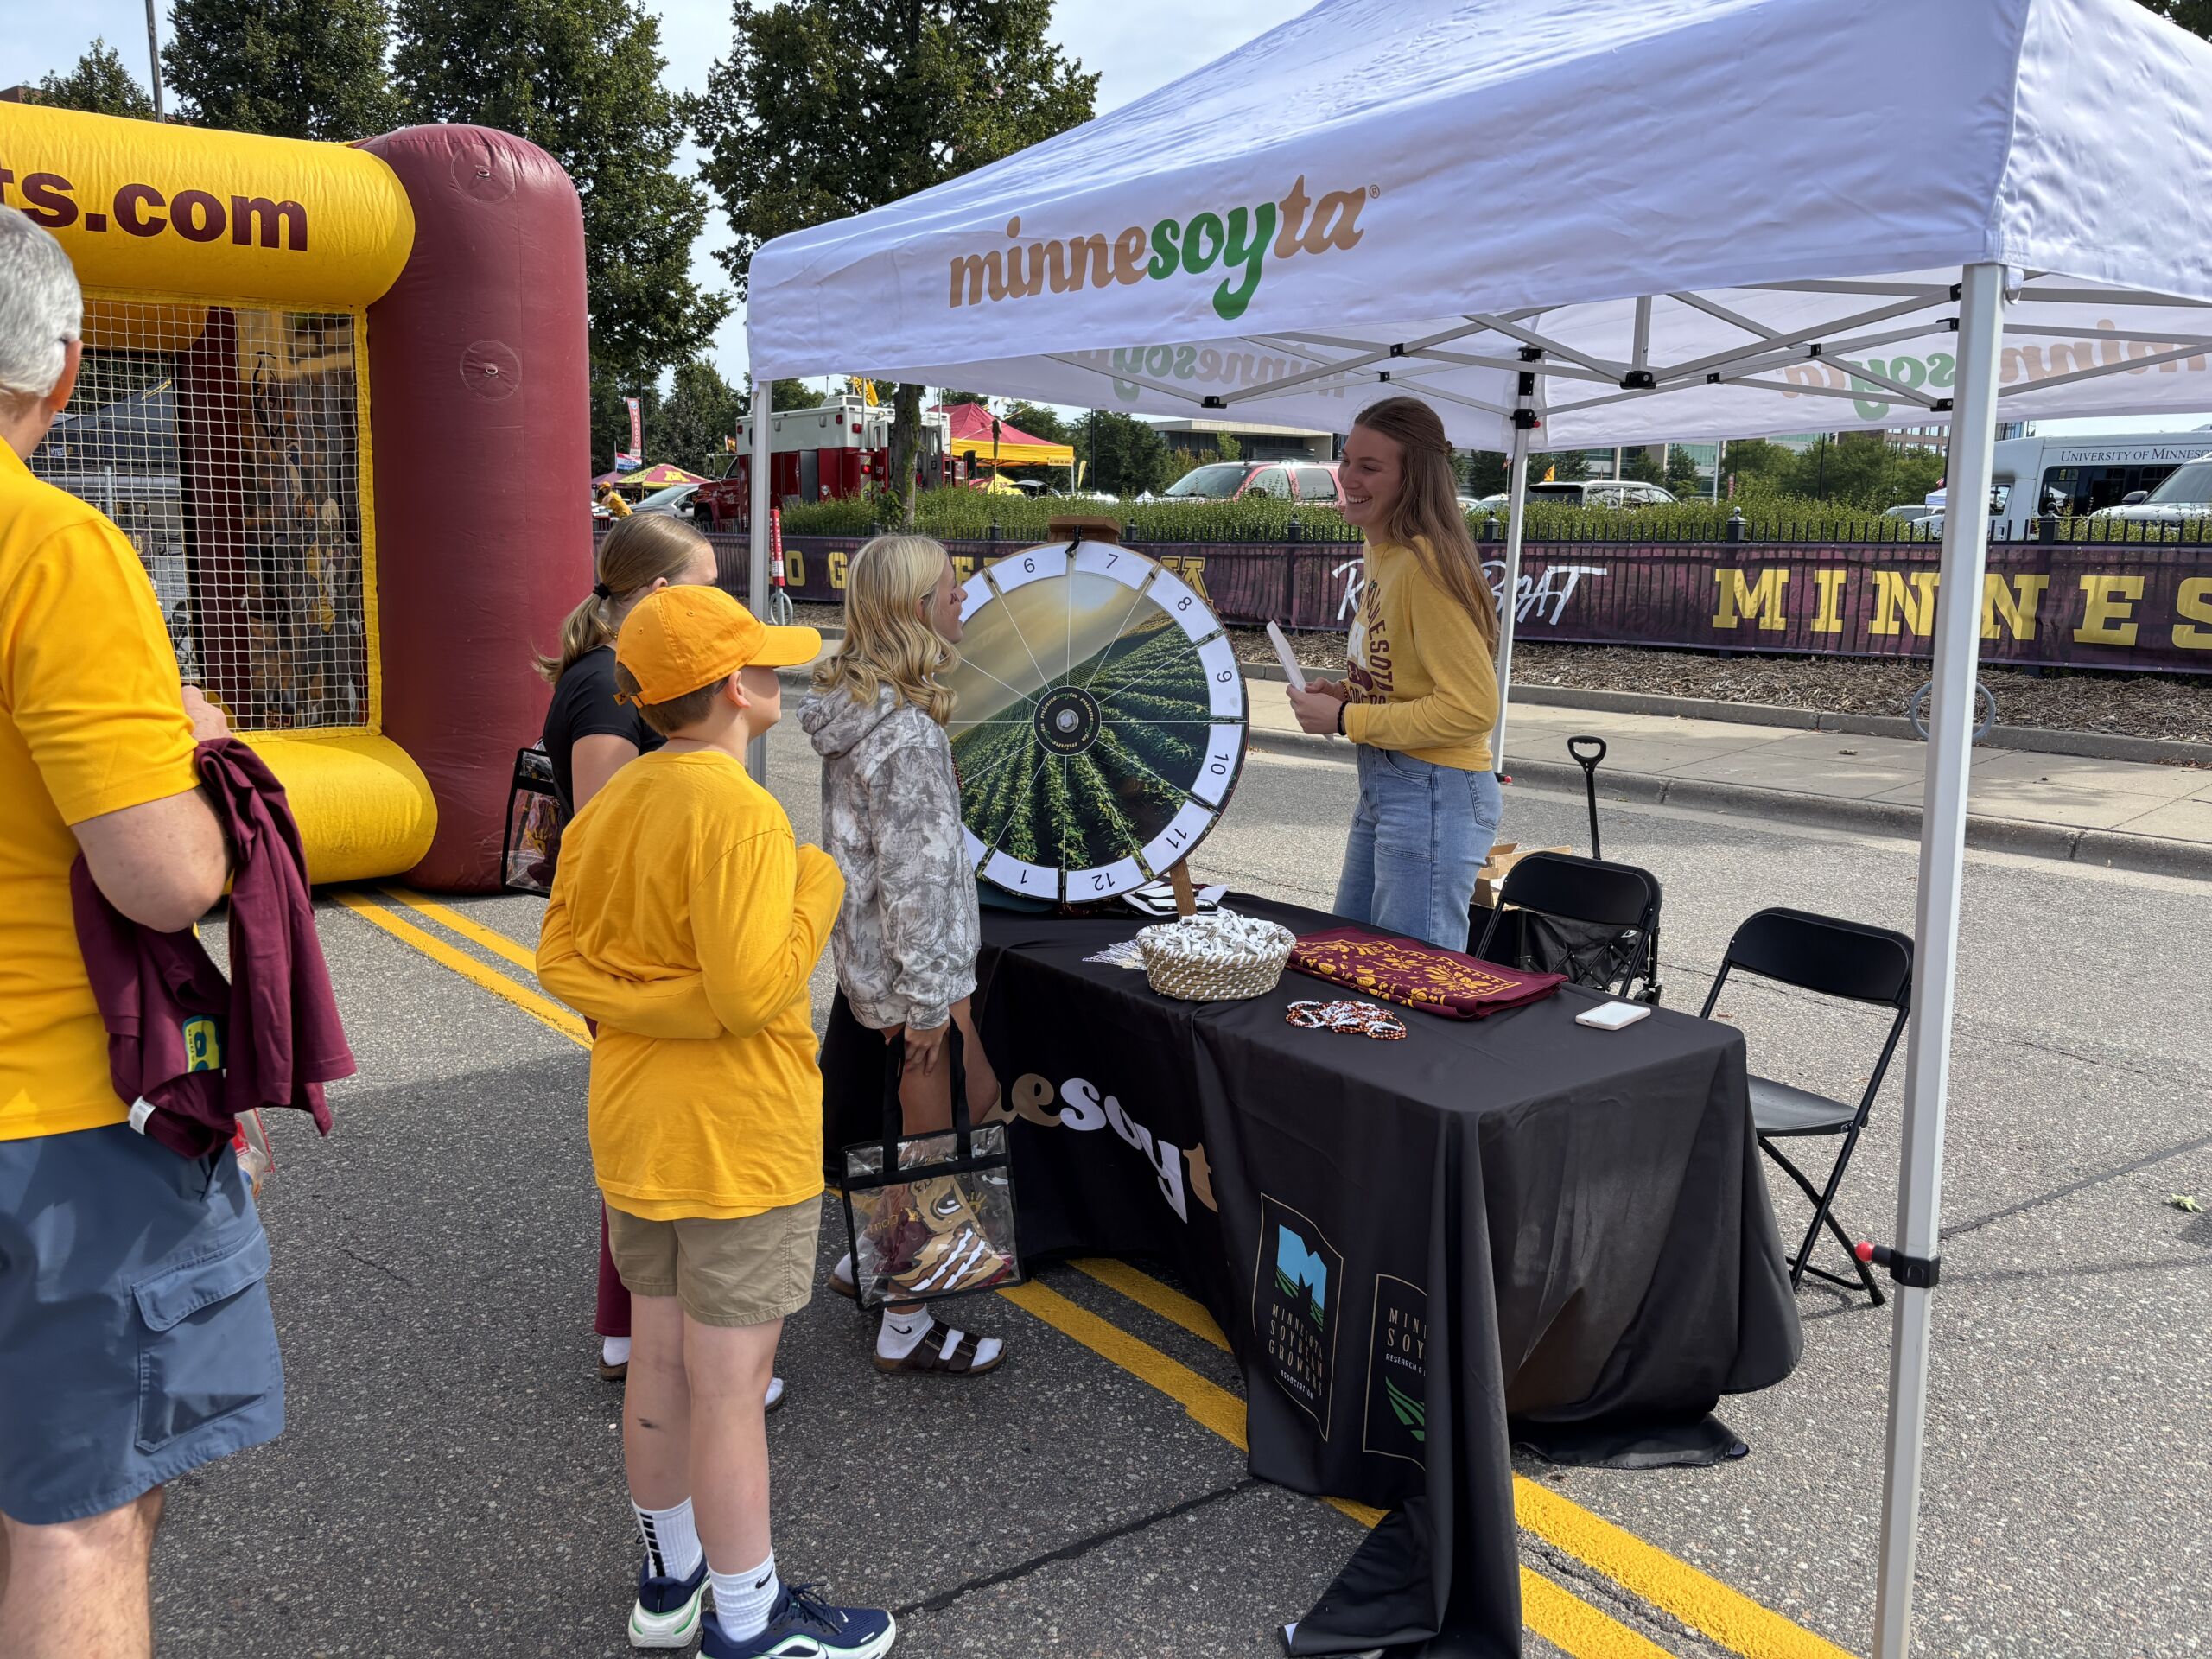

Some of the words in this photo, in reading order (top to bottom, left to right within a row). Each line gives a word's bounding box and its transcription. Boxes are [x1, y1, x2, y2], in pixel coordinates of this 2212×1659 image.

[1024, 558, 1035, 573] 6
[1106, 554, 1118, 569] 7
[1178, 597, 1192, 611] 8
[1217, 670, 1232, 683] 9
[1211, 753, 1230, 776] 10
[1166, 829, 1188, 849] 11
[1020, 869, 1028, 884] 1
[1091, 873, 1115, 891] 12
[1272, 1303, 1323, 1360] MINNESOTA
[1270, 1319, 1323, 1378] SOYBEAN
[1268, 1339, 1323, 1397] GROWERS
[1385, 1353, 1417, 1371] RESEARCH
